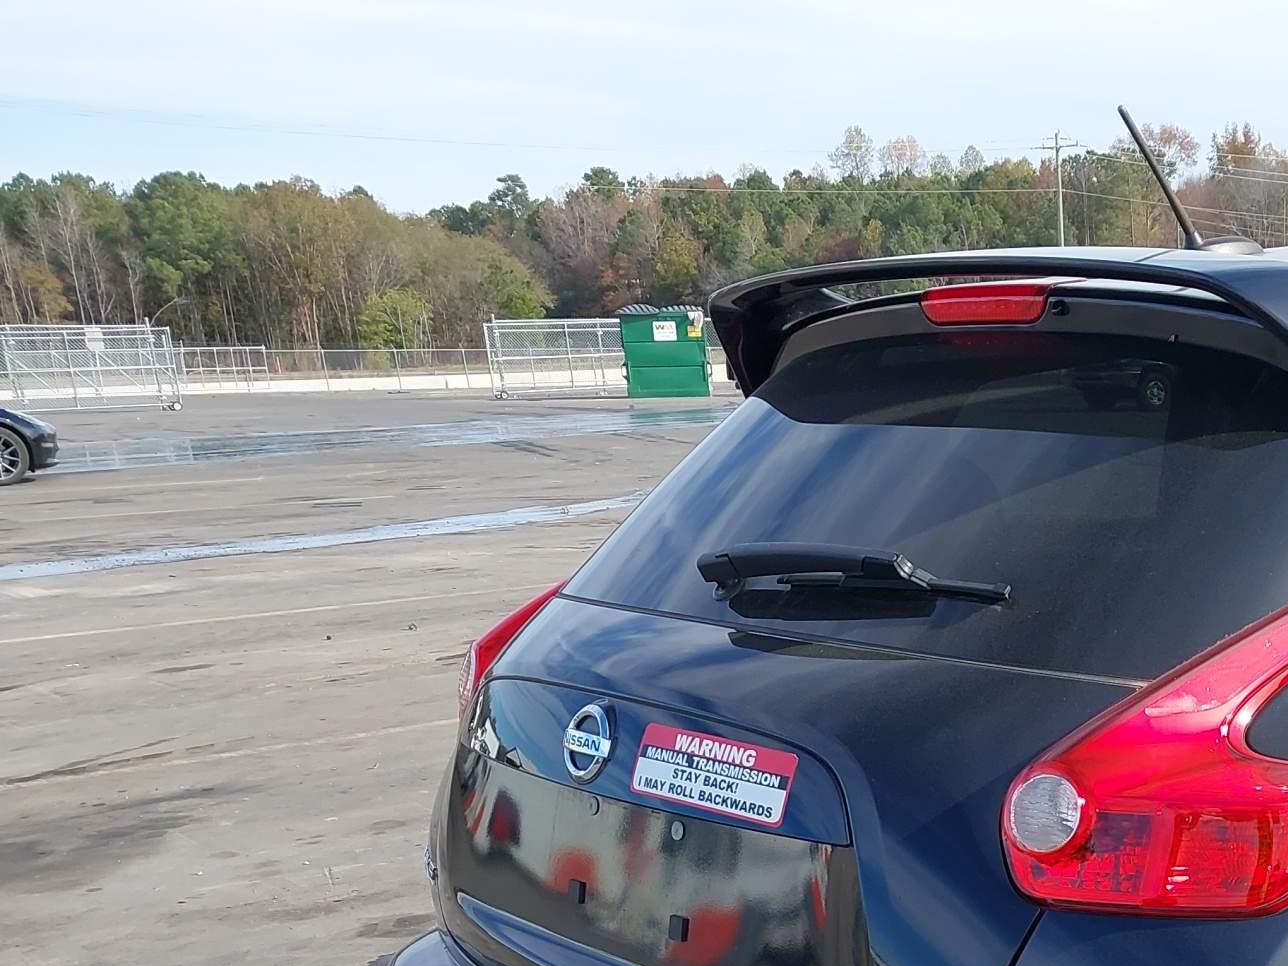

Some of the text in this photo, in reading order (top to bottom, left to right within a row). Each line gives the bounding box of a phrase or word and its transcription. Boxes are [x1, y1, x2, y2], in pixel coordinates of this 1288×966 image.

[564, 733, 601, 752] NISSAN
[675, 733, 757, 767] WARNING
[646, 747, 781, 788] MANUAL TRANSMISSION
[672, 768, 739, 795] STAY BACK!
[637, 775, 774, 819] I MAY ROLL BACKWARDS
